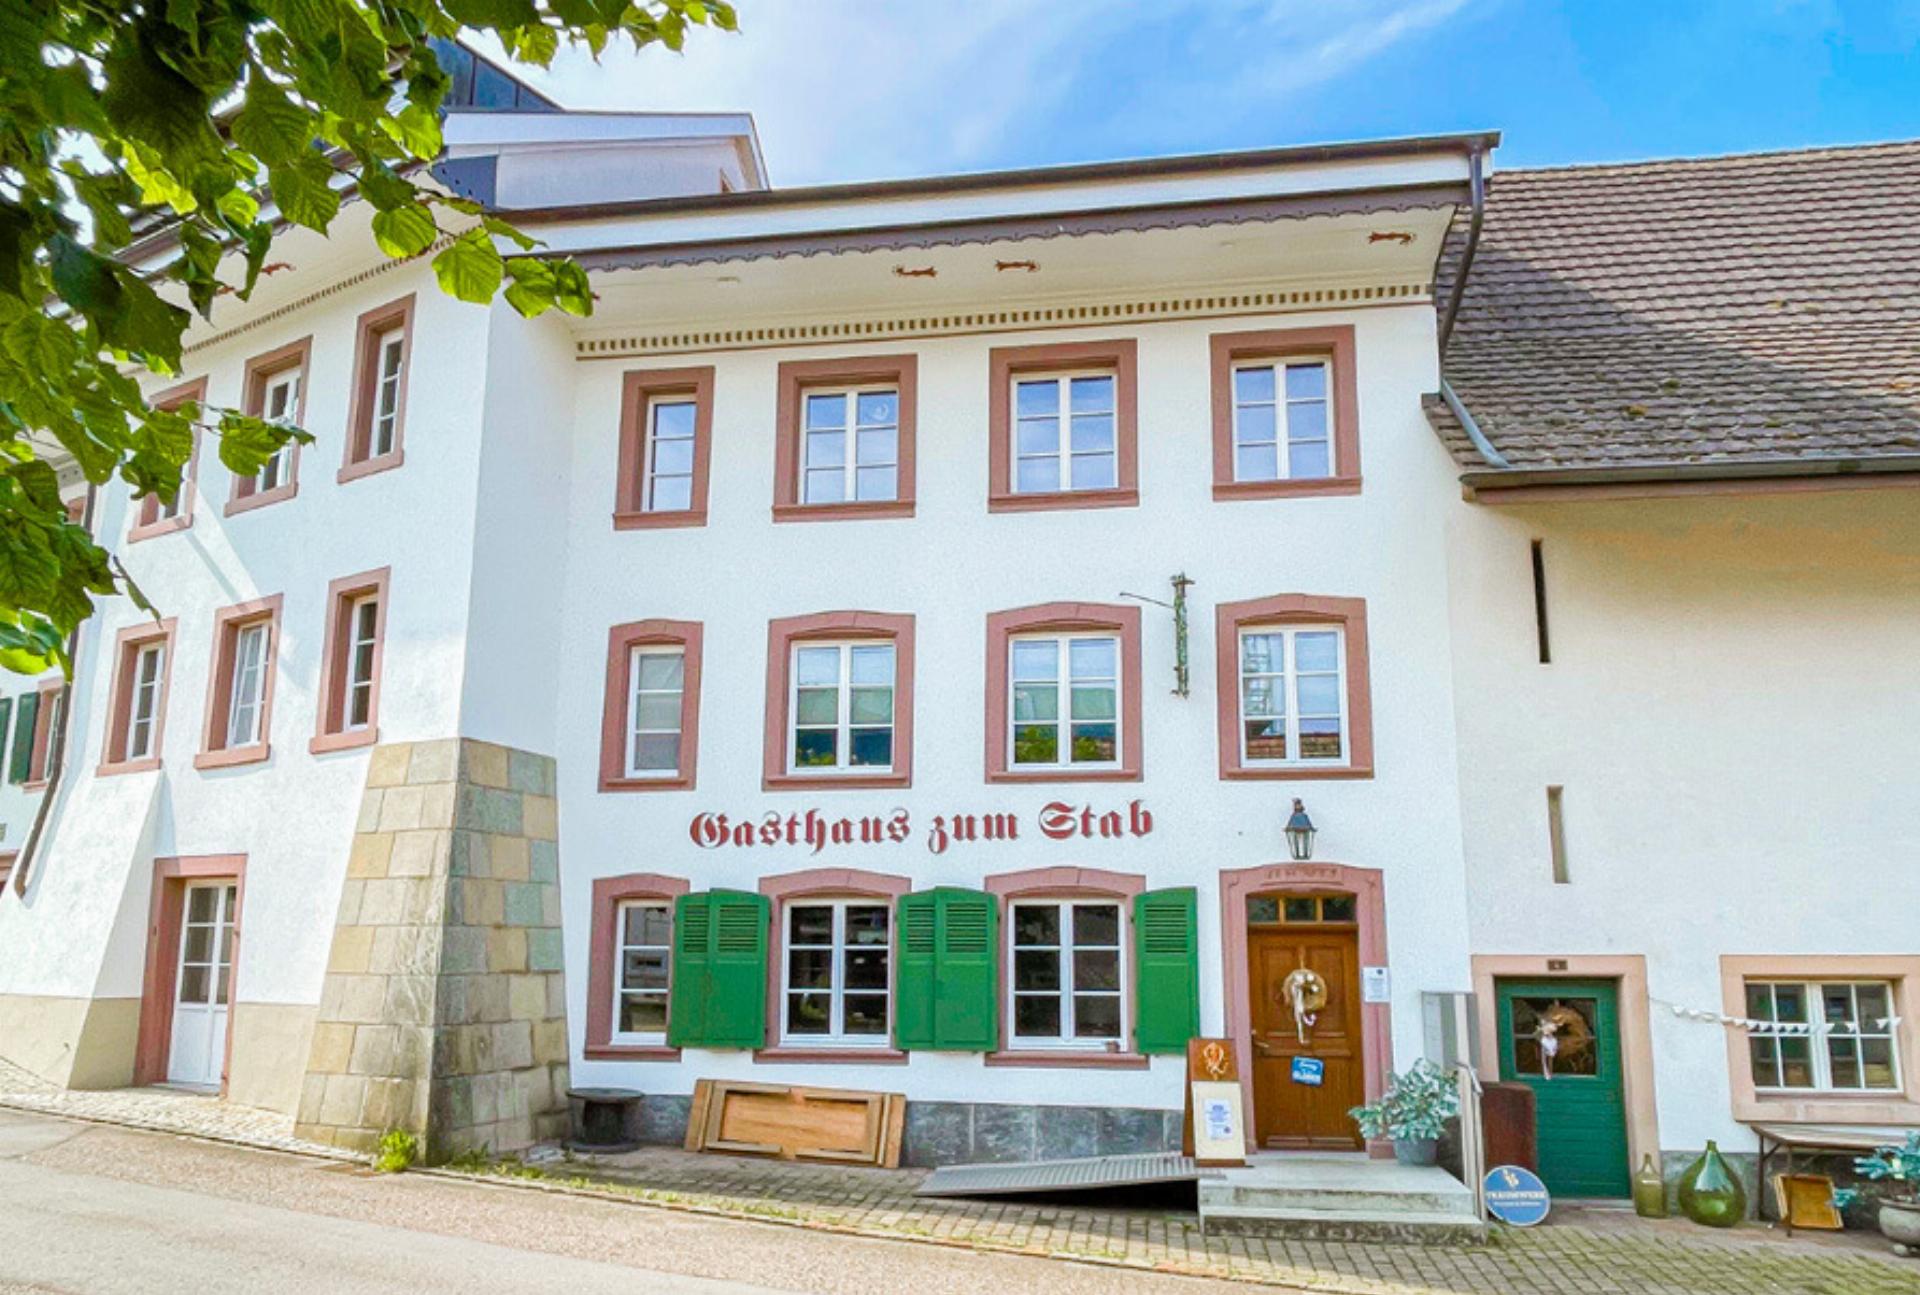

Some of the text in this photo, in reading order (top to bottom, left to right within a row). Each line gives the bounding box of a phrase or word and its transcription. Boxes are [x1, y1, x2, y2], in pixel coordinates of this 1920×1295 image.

[689, 799, 1154, 855] Gasthaus zum Stab
